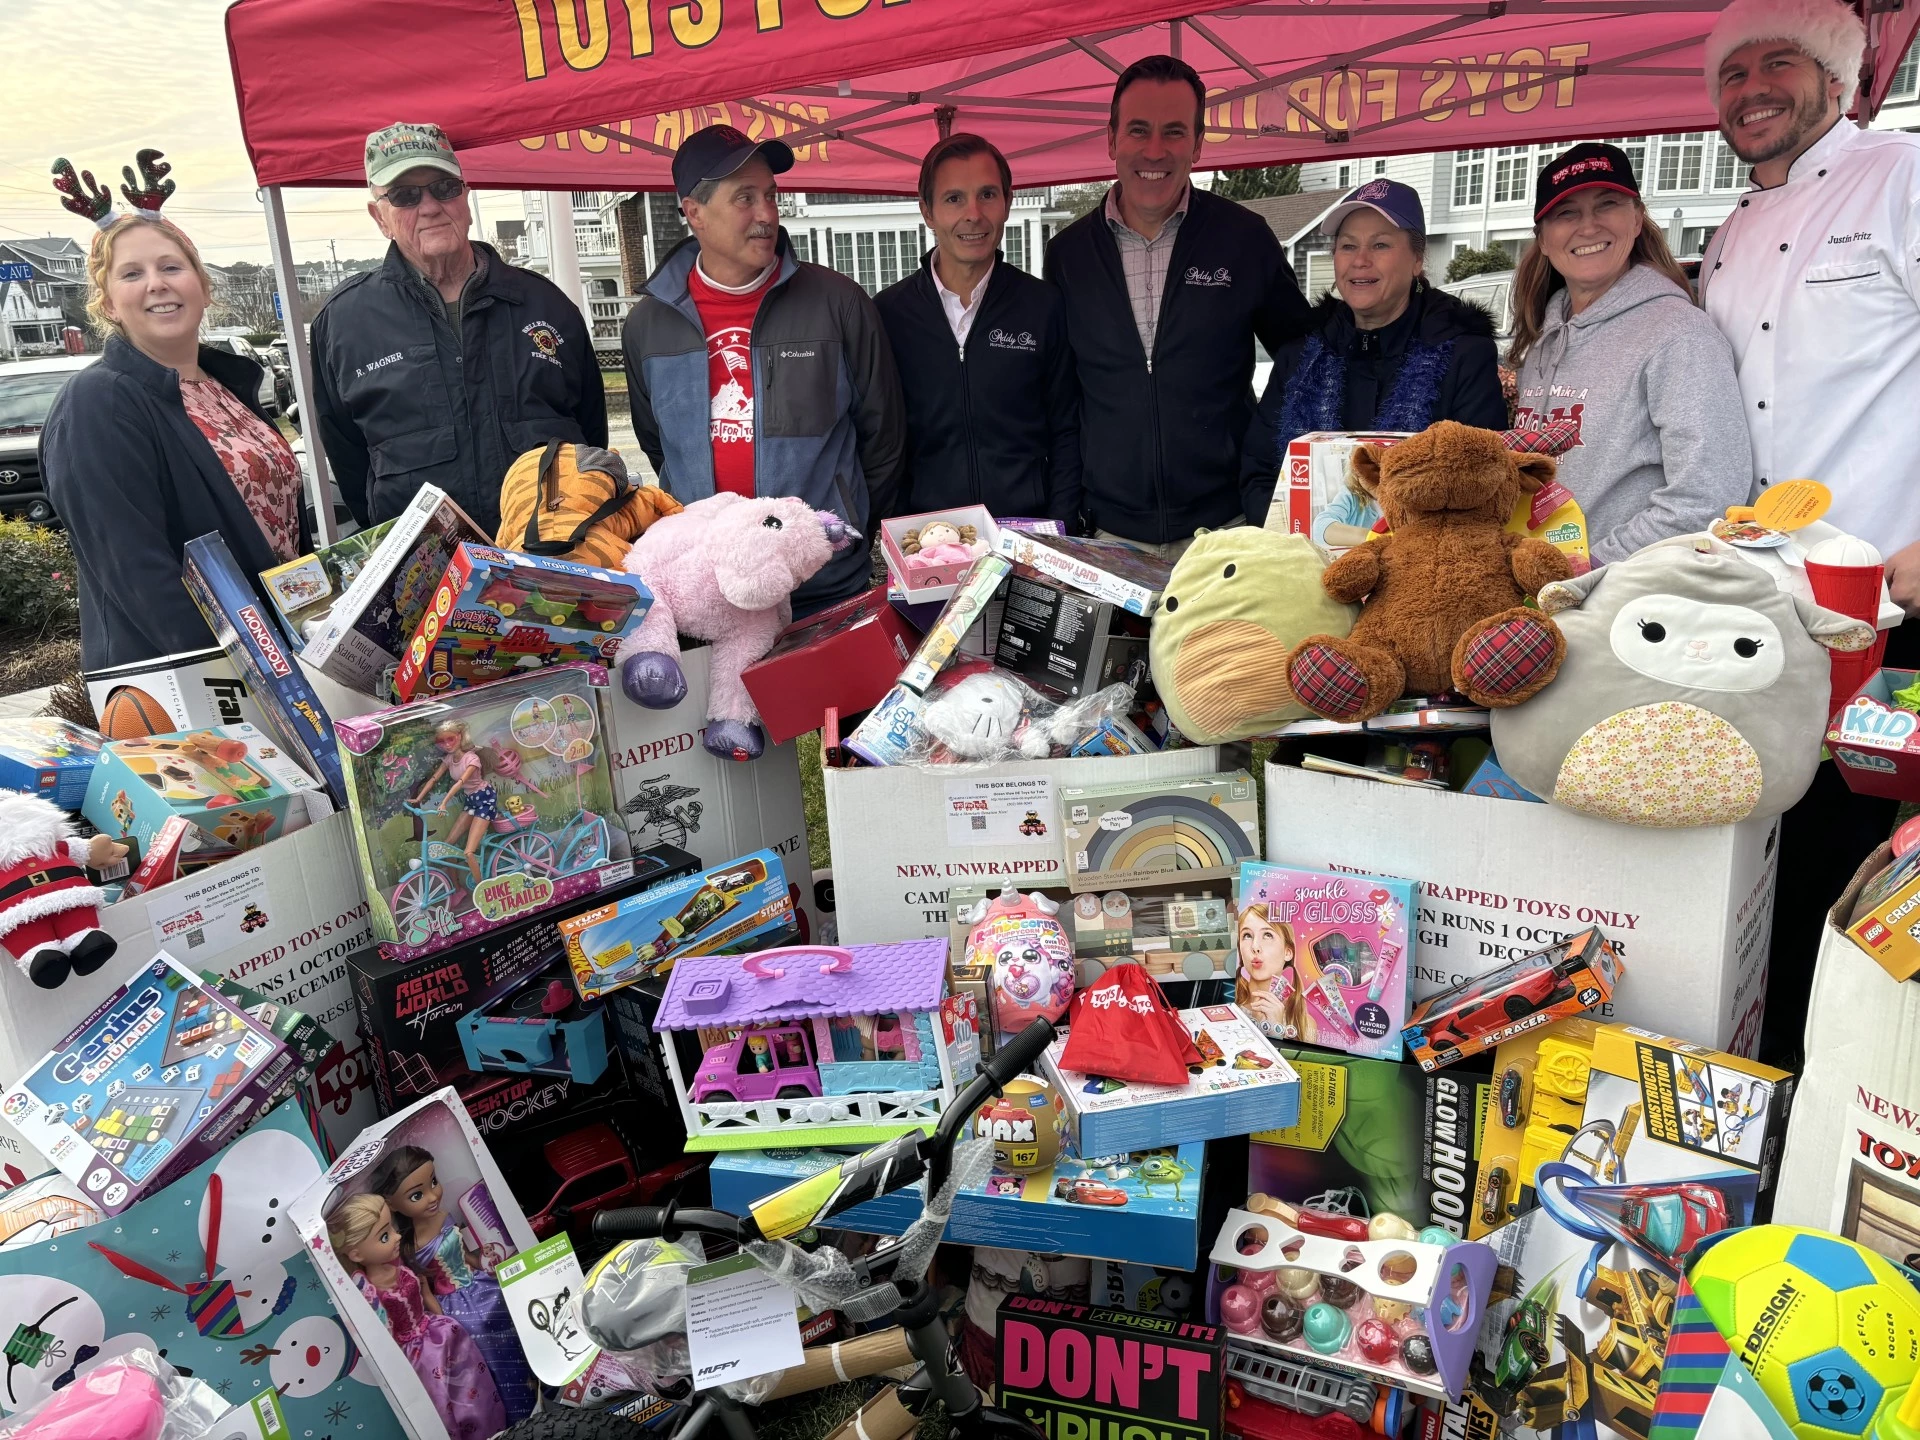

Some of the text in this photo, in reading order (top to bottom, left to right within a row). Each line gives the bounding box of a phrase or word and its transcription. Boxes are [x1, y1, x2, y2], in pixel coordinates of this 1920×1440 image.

[371, 125, 440, 147] VIETNAM
[382, 141, 437, 157] VETERAN
[1553, 169, 1569, 180] TOYS
[1591, 160, 1608, 168] TOTS
[1828, 231, 1872, 244] Justin Fritz
[10, 265, 32, 279] AVE
[356, 351, 404, 378] R. WAGNER
[1578, 388, 1588, 400] A
[722, 426, 739, 436] FOR
[1292, 476, 1308, 484] Hape
[1549, 533, 1580, 543] BRICKS
[542, 559, 590, 574] train set
[1043, 552, 1100, 583] CANDY LAND
[452, 619, 497, 635] wheels
[454, 609, 487, 624] baby
[240, 609, 290, 674] MONOPOLY
[350, 635, 377, 658] United
[335, 642, 373, 673] States Map
[471, 658, 497, 667] choo!
[167, 675, 182, 721] OFFICIAL
[1846, 707, 1913, 737] KID
[1843, 733, 1902, 748] Connection
[1838, 751, 1895, 768] KID
[41, 775, 56, 783] LEGO
[141, 821, 181, 877] Chess
[896, 860, 1059, 879] NEW, UNWRAPPED
[1077, 866, 1175, 883] Wooden Stackable Rainbow Blue
[1247, 869, 1289, 880] MINE DESIGN
[184, 866, 262, 901] THIS BOX BELONGS TO:
[483, 881, 512, 903] BIKE
[1294, 880, 1349, 902] sparkle
[498, 884, 549, 912] TRAILER
[760, 896, 790, 918] STUNT
[565, 907, 611, 929] STUNT
[1267, 901, 1379, 924] LIP GLOSS
[1513, 897, 1571, 919] TOYS
[1576, 907, 1640, 930] ONLY
[288, 921, 333, 953] TOYS
[334, 900, 372, 930] ONLY
[406, 906, 456, 947] Steffi
[975, 919, 1060, 944] Rainbocorns
[996, 928, 1040, 940] PUPPYCORN
[1442, 911, 1495, 935] RUNS
[1501, 924, 1509, 938] 1
[1864, 922, 1885, 942] LEGO
[492, 923, 555, 967] LED LIGHT STRIPS
[506, 923, 543, 950] RINK SIZE
[1057, 937, 1066, 946] 10
[288, 927, 374, 982] 1 OCTOBER
[493, 935, 549, 974] HIGH-POWER FAN
[494, 950, 539, 981] BRIGHT NEON
[403, 959, 448, 980] CLASSIC
[396, 963, 463, 999] RETRO
[395, 979, 470, 1019] WORLD
[1095, 990, 1116, 1003] TOYS
[1582, 989, 1592, 999] 27
[65, 994, 118, 1044] GENIUS BATTLE GAME
[405, 999, 463, 1040] Horizon
[1209, 1008, 1226, 1017] 26
[1369, 1012, 1376, 1021] 3
[53, 986, 162, 1084] Genius
[293, 1024, 307, 1039] ROLL
[298, 1026, 311, 1040] SPELL
[953, 1020, 972, 1046] KID
[1359, 1020, 1386, 1029] FLAVORED
[1360, 1026, 1385, 1036] GLOSSES!
[1483, 1014, 1548, 1046] RC RACER
[84, 1010, 162, 1083] SQUARE
[1424, 1062, 1433, 1070] 5+
[467, 1078, 533, 1118] ESKTOP
[1327, 1067, 1337, 1108] FEATURES:
[1640, 1046, 1664, 1138] CONSTRUCTION
[476, 1077, 571, 1135] HOCKEY
[1434, 1077, 1459, 1145] GLOW
[1656, 1060, 1680, 1143] DESTRUCTION
[1856, 1084, 1920, 1136] NEW,
[977, 1114, 1035, 1142] MAX
[1457, 1085, 1469, 1149] GAME TIME
[140, 1143, 163, 1165] WARNING:
[1015, 1151, 1036, 1162] 167
[92, 1172, 102, 1183] 2
[106, 1184, 121, 1201] 6+
[534, 1243, 568, 1264] FREE ASSEMBLY
[692, 1273, 713, 1282] KIDS
[691, 1316, 713, 1325] Warranty:
[1008, 1295, 1217, 1341] DON'T PUSH IT!
[1745, 1283, 1796, 1355] DESIGN
[1857, 1299, 1879, 1357] OFFICIAL
[1886, 1311, 1895, 1360] SOCCER
[1909, 1339, 1919, 1361] SIZE
[697, 1359, 741, 1377] HUFFY
[1003, 1319, 1211, 1421] DON'T
[1828, 1385, 1840, 1395] 5
